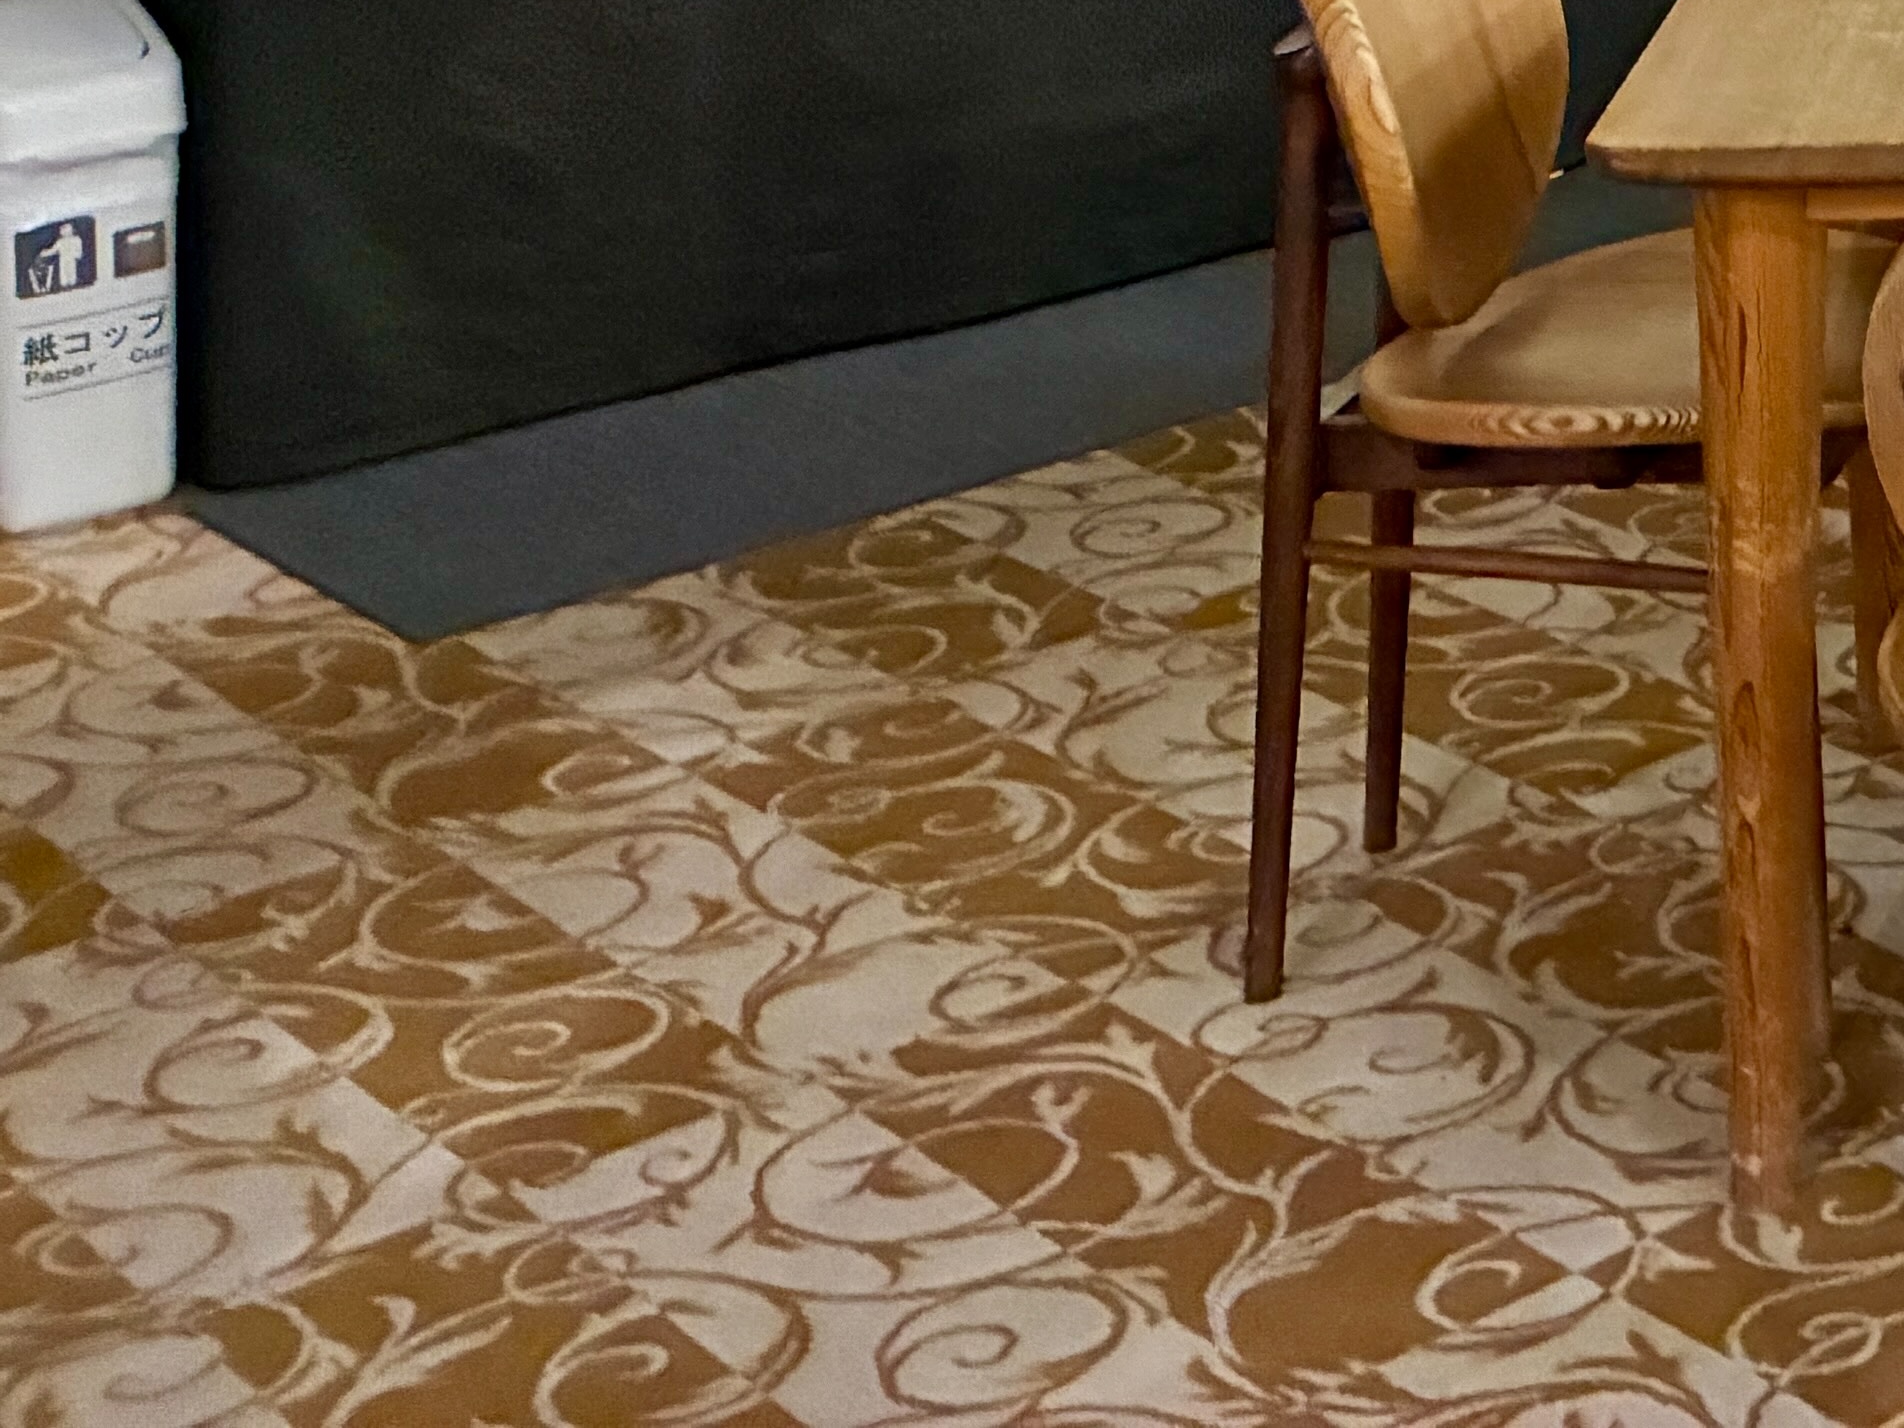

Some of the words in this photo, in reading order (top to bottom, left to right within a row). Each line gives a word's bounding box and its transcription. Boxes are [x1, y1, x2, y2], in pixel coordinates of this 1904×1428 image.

[23, 305, 166, 366] 紙コップ
[25, 362, 97, 386] Paper
